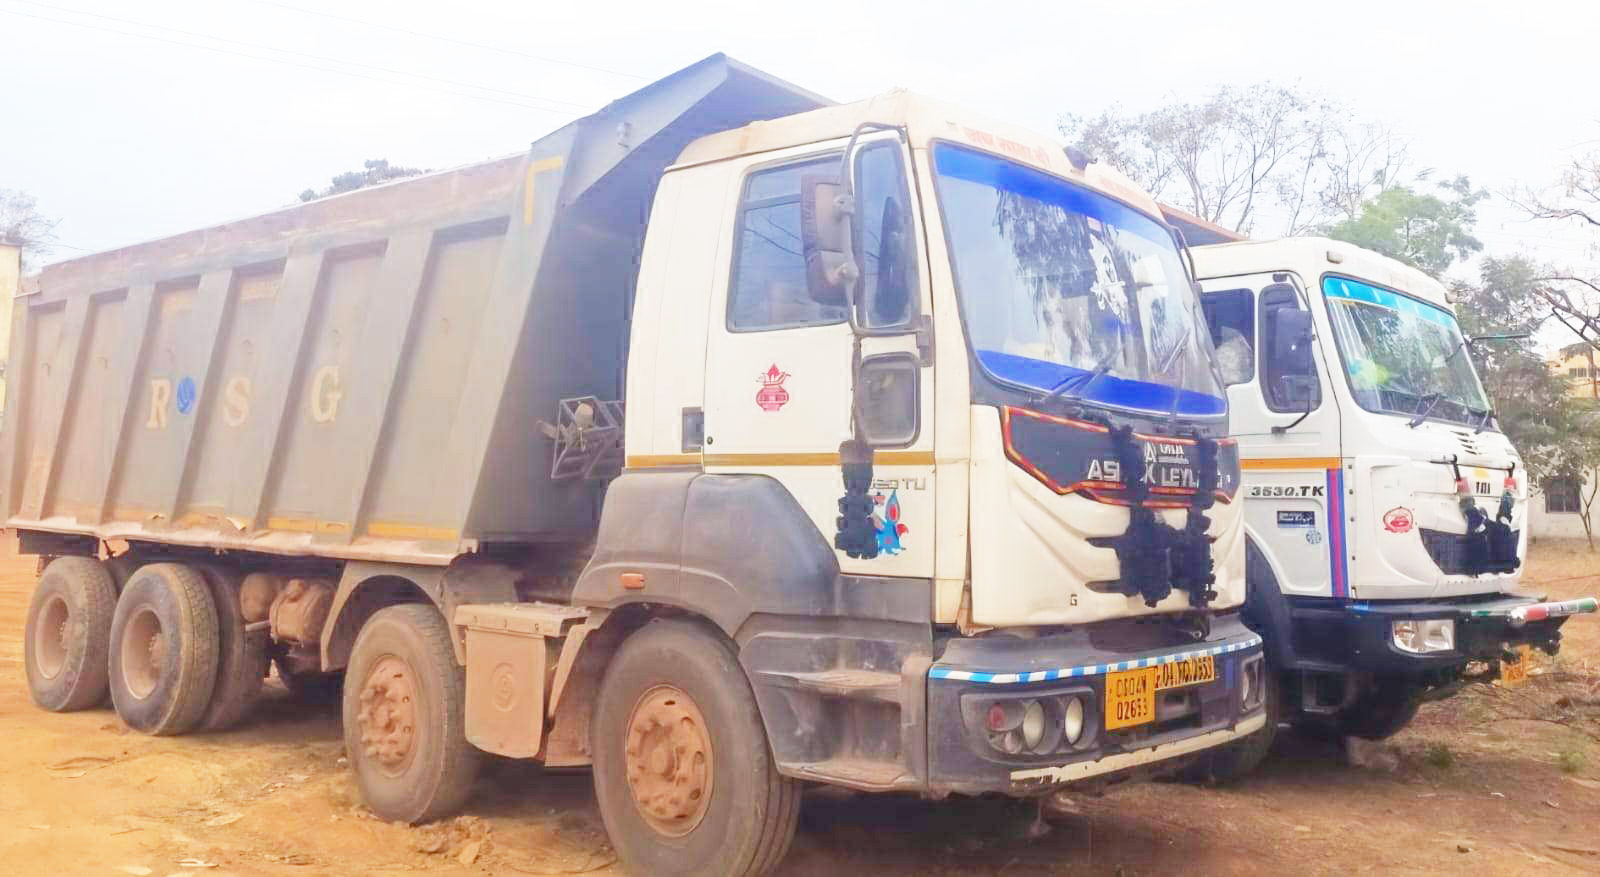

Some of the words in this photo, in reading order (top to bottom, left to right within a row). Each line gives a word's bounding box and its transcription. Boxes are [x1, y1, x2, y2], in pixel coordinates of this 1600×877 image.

[146, 378, 172, 430] R
[223, 376, 251, 428] S
[312, 365, 343, 424] G
